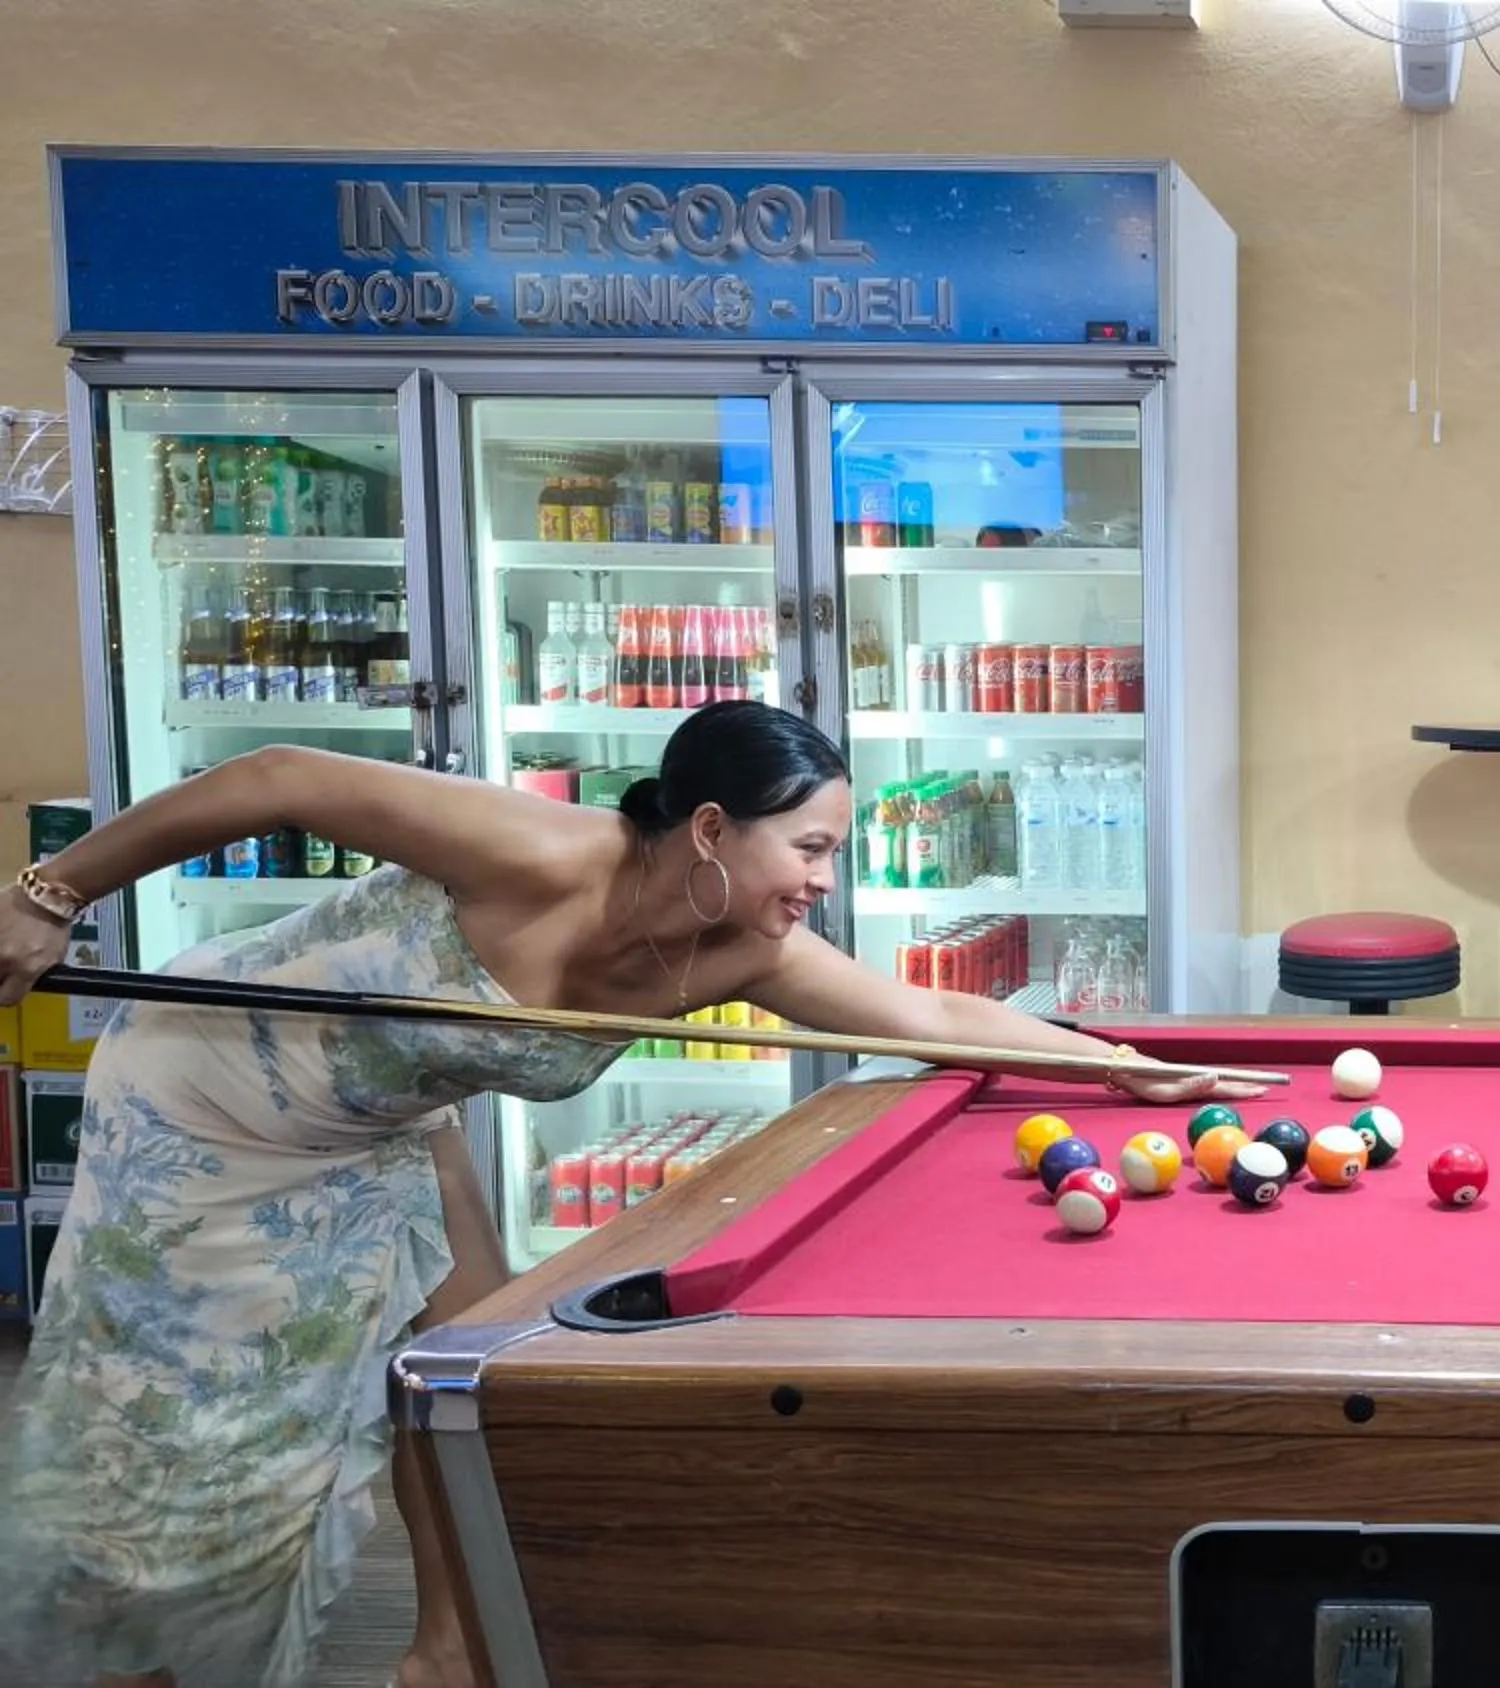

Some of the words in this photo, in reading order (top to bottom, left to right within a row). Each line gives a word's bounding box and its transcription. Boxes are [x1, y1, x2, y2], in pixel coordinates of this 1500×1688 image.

[337, 180, 870, 260] INTERCOOL
[275, 269, 455, 325] FOOD
[515, 272, 751, 328] DRINKS
[812, 276, 953, 329] DELI
